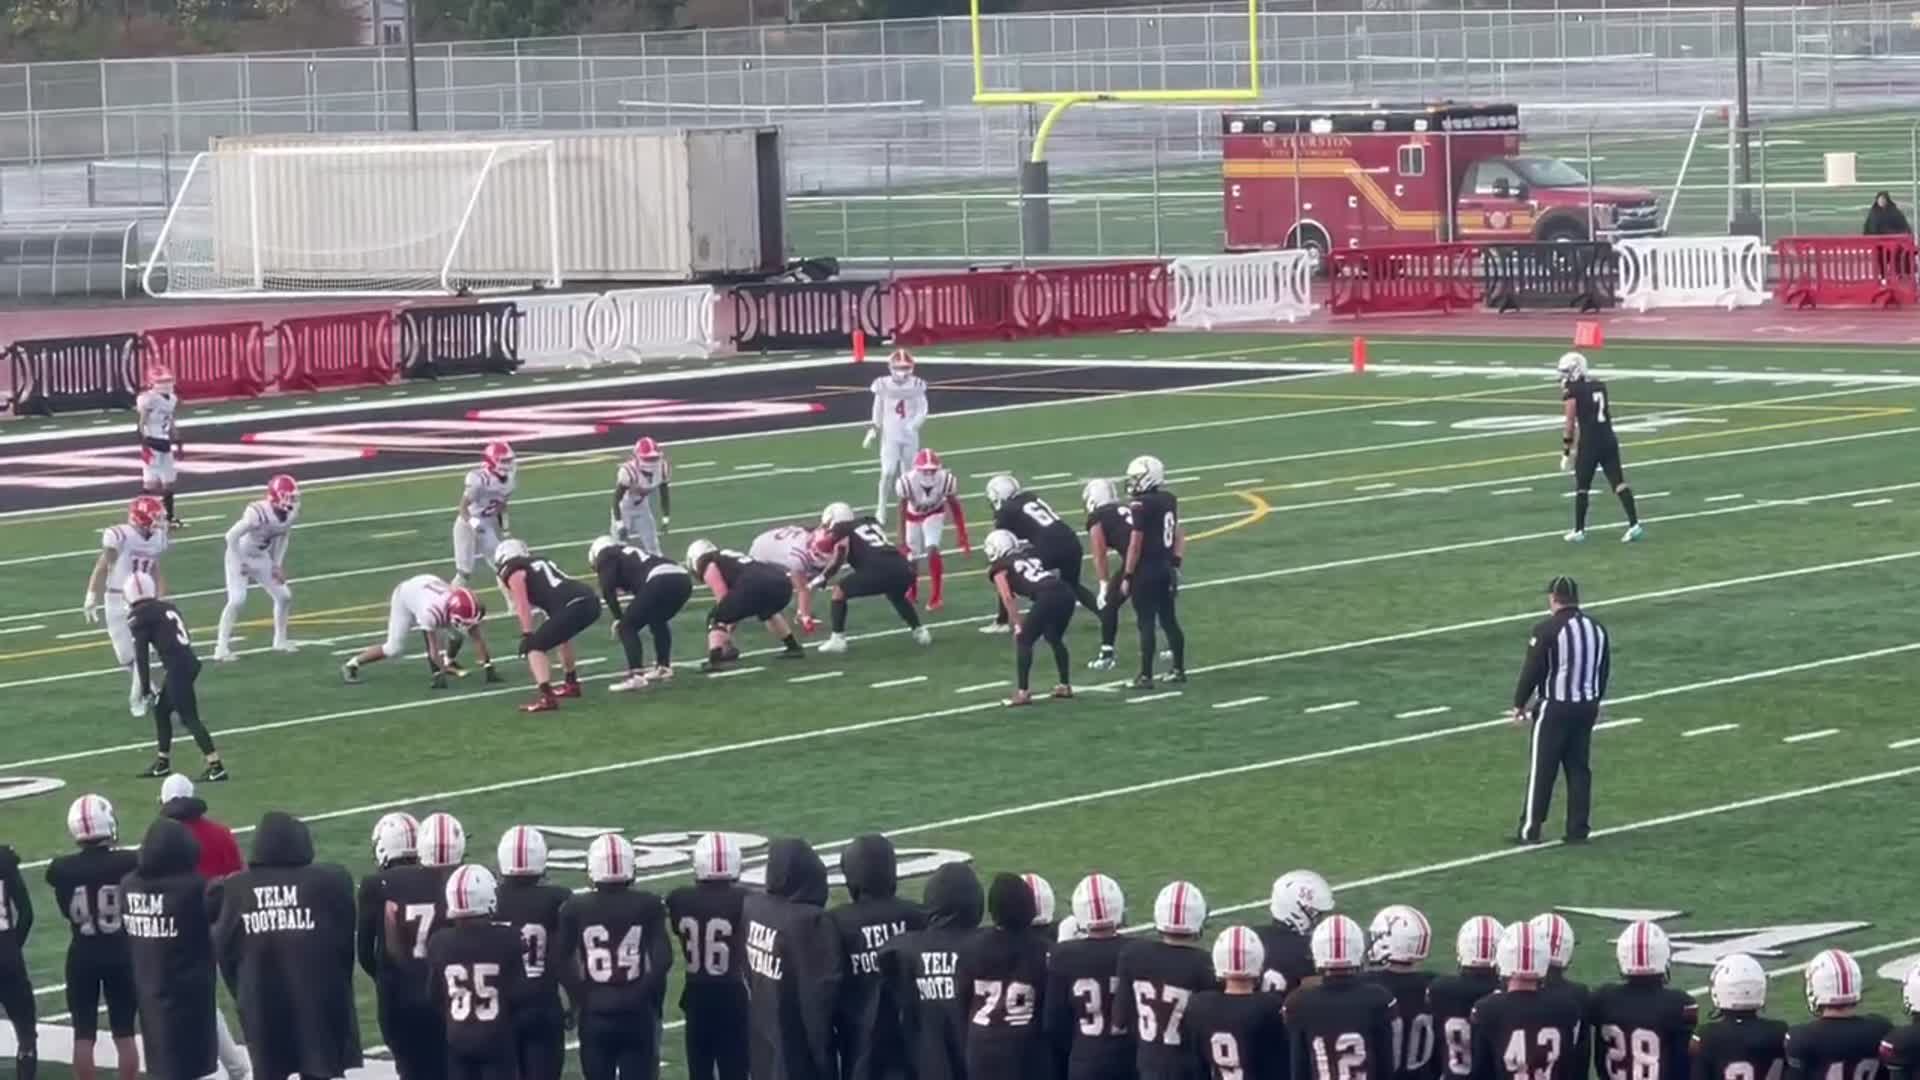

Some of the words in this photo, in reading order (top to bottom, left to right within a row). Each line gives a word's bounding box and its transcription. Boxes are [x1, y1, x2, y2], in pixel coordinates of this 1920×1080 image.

[895, 399, 906, 419] 4
[1592, 391, 1606, 423] 7
[1162, 511, 1176, 548] 8
[165, 609, 190, 645] 3
[253, 885, 298, 909] YELM
[241, 907, 316, 934] FOOTBALL
[583, 924, 643, 982] 64
[444, 963, 500, 1021] 65
[1132, 980, 1192, 1046] 67
[1312, 1032, 1367, 1080] 12
[1391, 1013, 1434, 1071] 10
